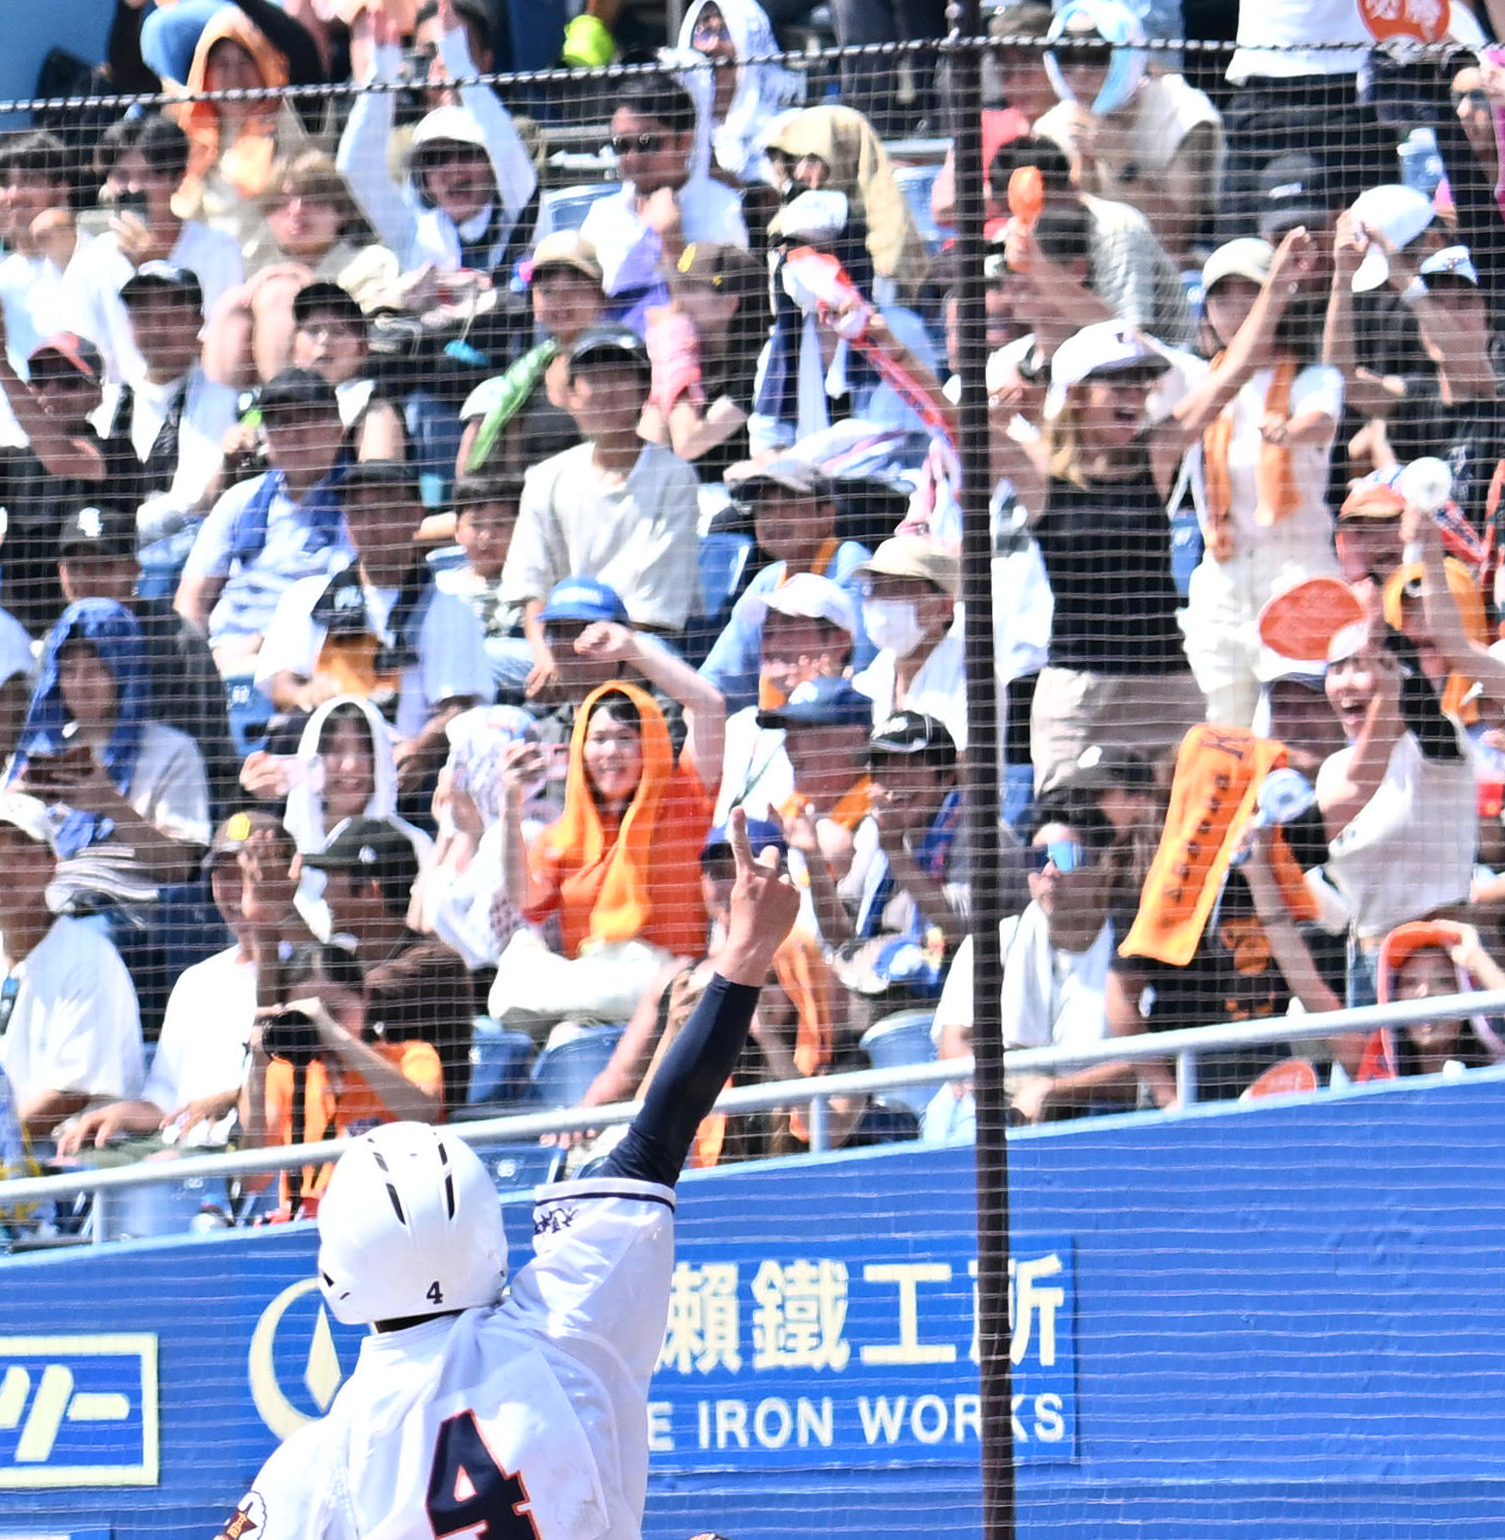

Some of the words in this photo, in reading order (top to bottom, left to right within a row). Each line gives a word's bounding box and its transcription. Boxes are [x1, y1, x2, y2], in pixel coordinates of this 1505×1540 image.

[426, 1281, 444, 1305] 4
[699, 1396, 833, 1449] IRON
[857, 1393, 1065, 1444] WORKS
